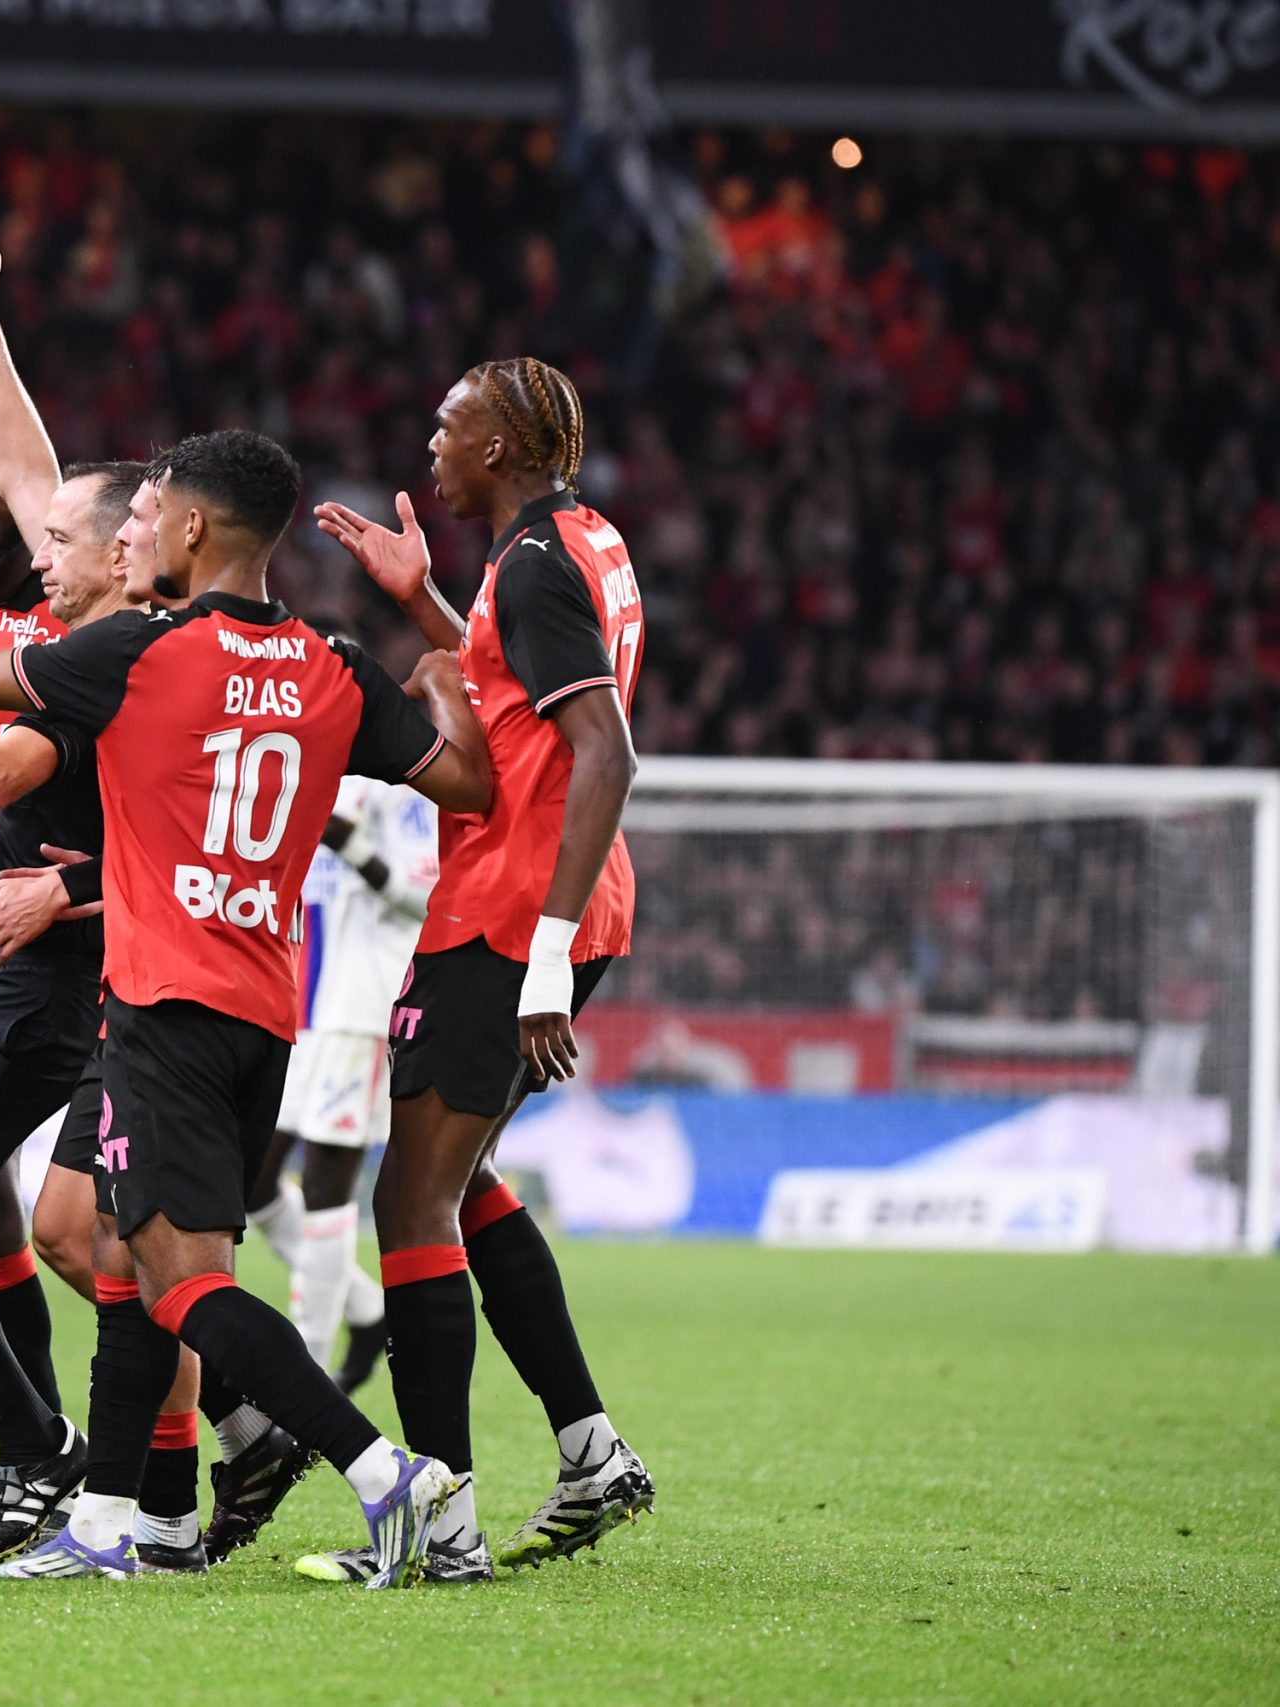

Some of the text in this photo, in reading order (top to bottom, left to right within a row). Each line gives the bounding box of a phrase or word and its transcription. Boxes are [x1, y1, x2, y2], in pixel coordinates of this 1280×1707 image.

[224, 674, 302, 718] BLAS
[202, 727, 302, 862] 10
[174, 864, 279, 935] Blot
